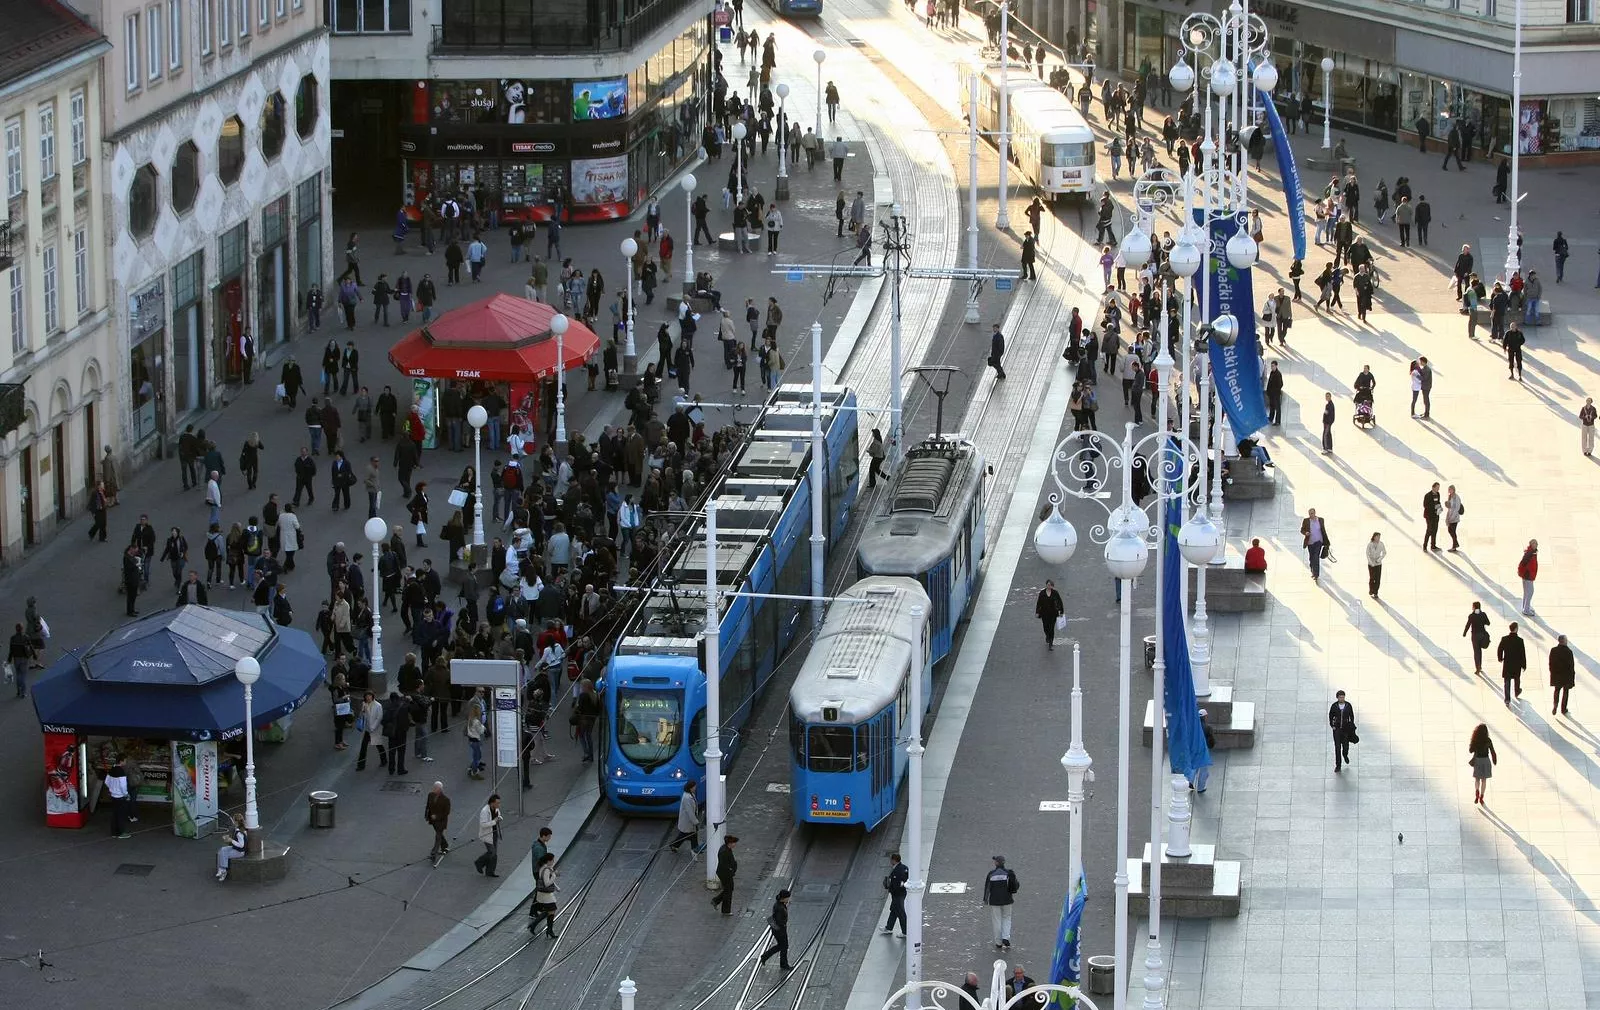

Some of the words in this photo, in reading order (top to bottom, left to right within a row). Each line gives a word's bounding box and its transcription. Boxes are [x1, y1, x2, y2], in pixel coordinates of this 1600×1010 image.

[470, 97, 494, 109] slušaj
[447, 143, 484, 151] multimedija
[1214, 232, 1233, 301] Zagrebački
[1224, 369, 1244, 412] tjedan
[455, 370, 481, 378] TISAK
[132, 660, 173, 668] iNovine
[43, 725, 75, 733] iNovine
[221, 727, 243, 740] iNovine
[203, 753, 211, 809] Jamnica
[824, 798, 837, 806] 710
